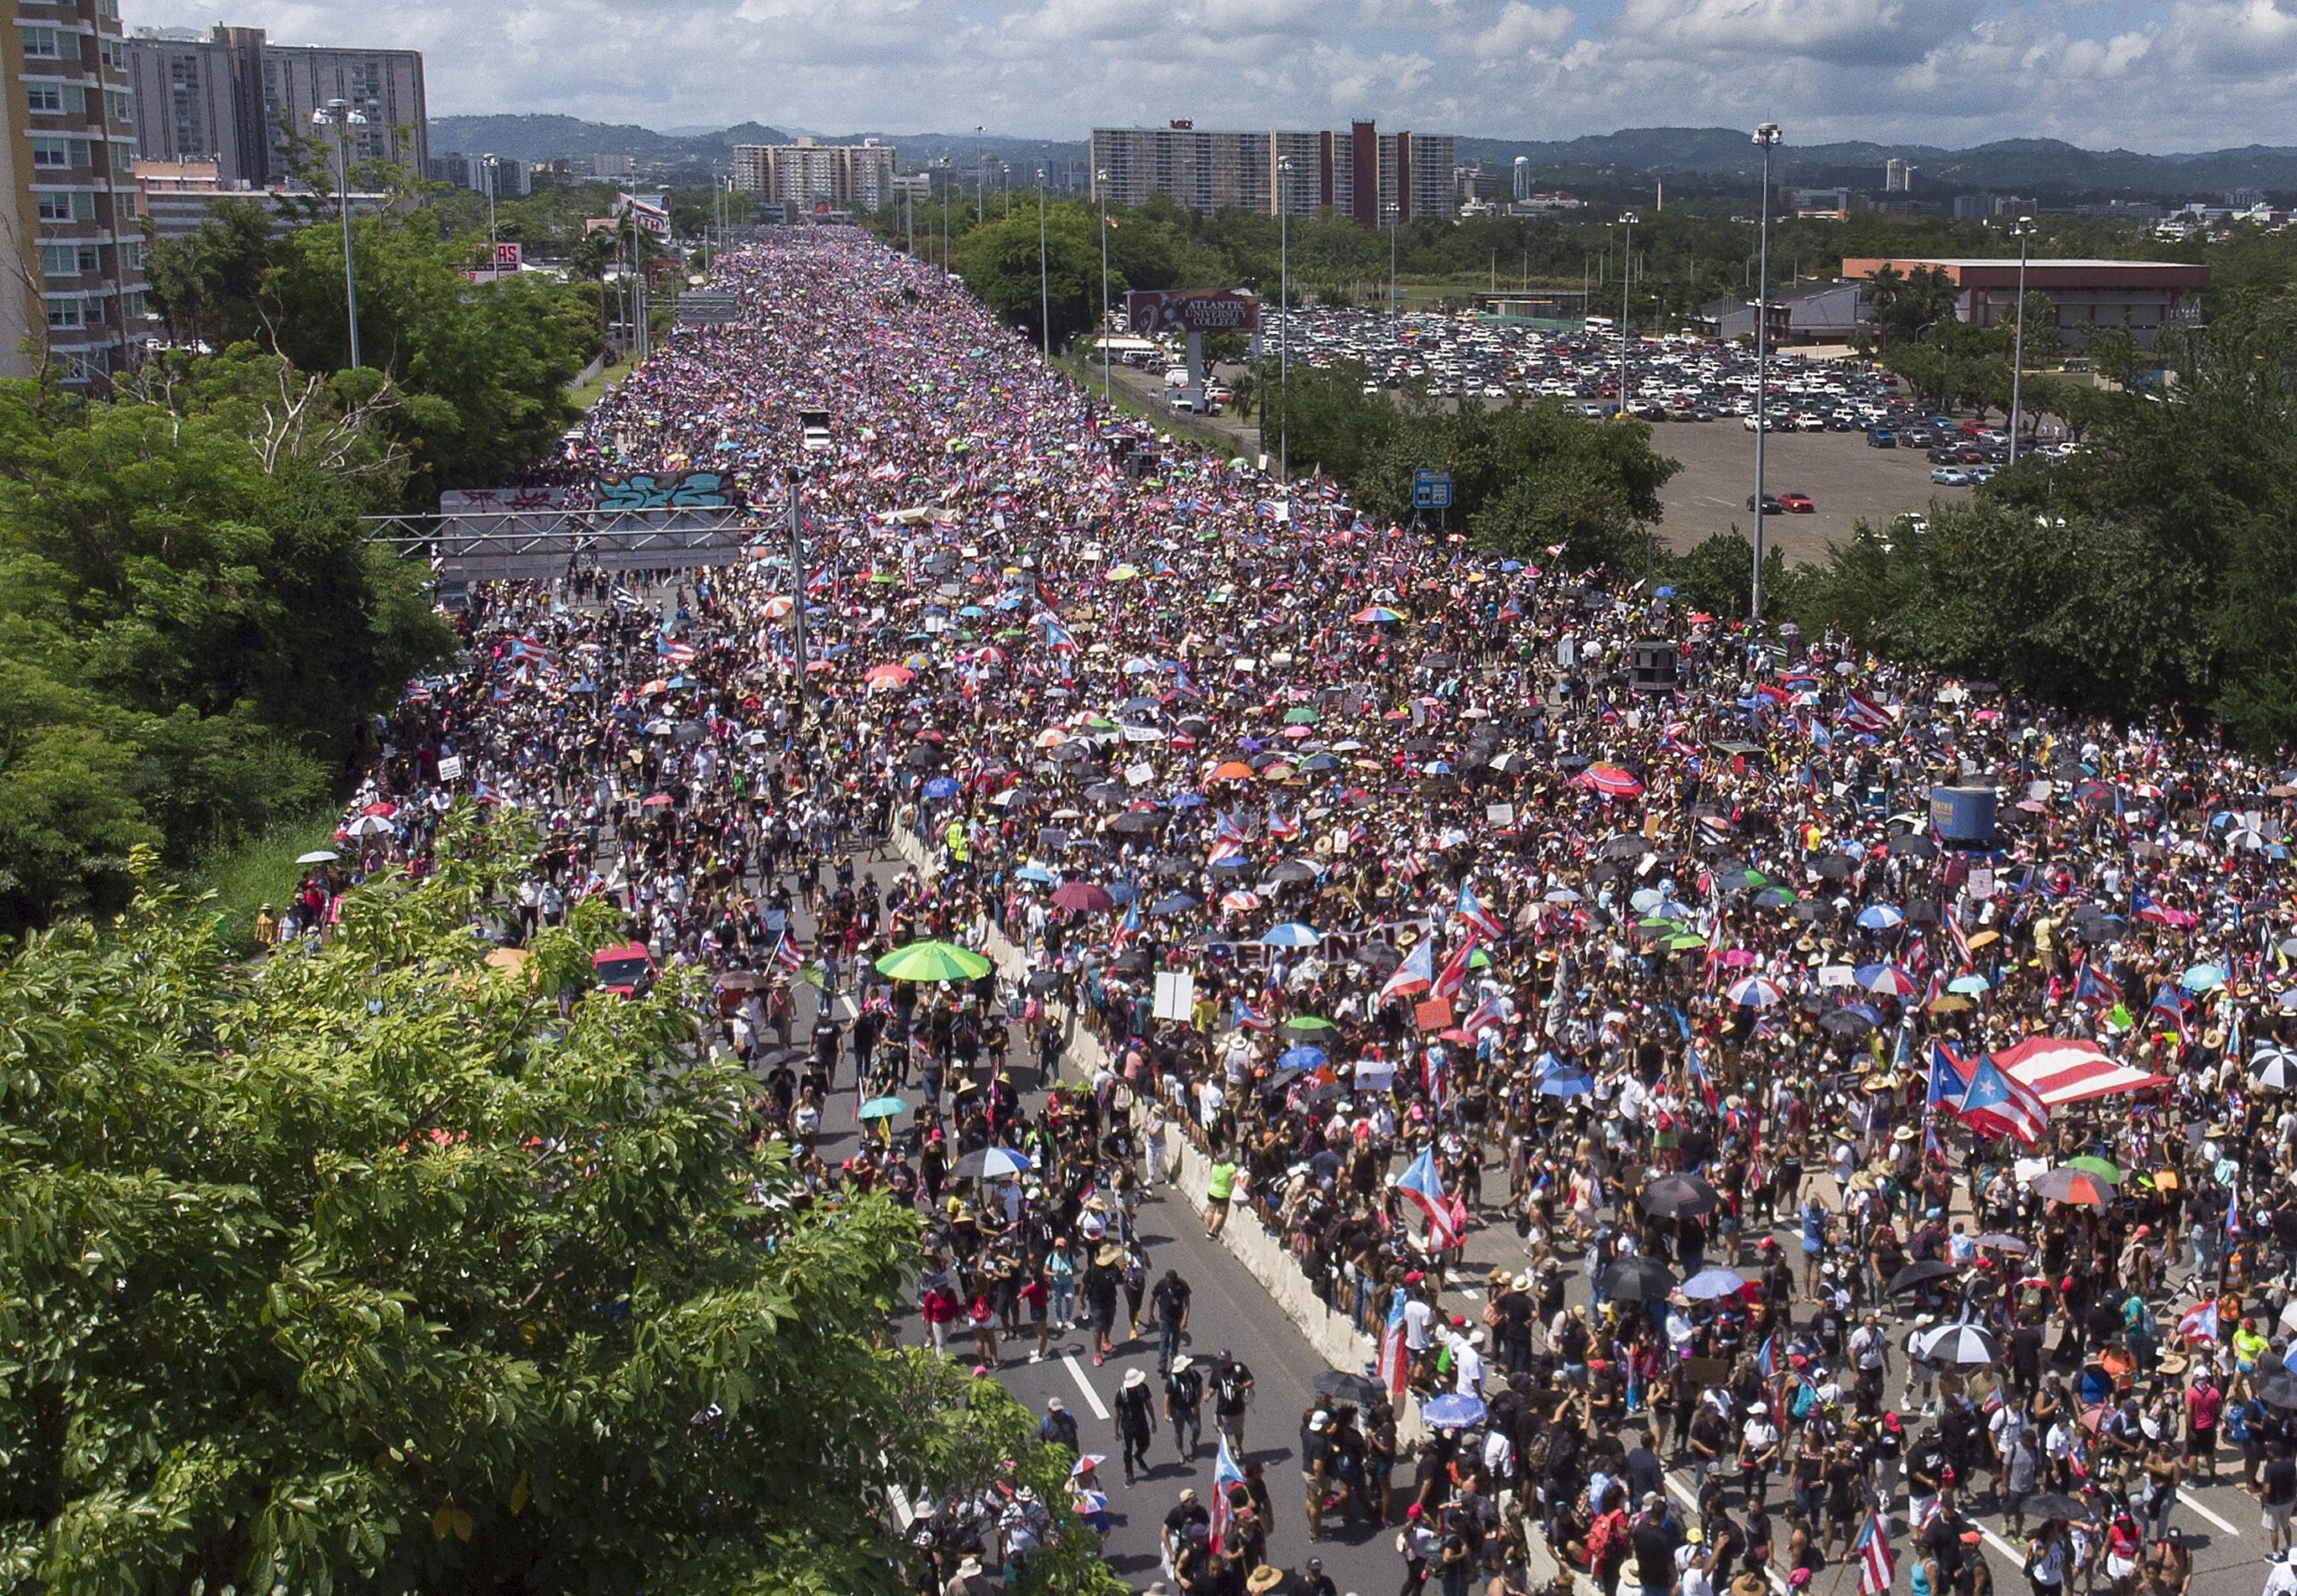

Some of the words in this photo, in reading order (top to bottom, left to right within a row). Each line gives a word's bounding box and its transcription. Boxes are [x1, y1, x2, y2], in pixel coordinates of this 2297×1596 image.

[1188, 301, 1245, 310] ATLANTIC
[1185, 310, 1247, 318] UNIVERSITY
[1193, 318, 1239, 326] COLLEGE
